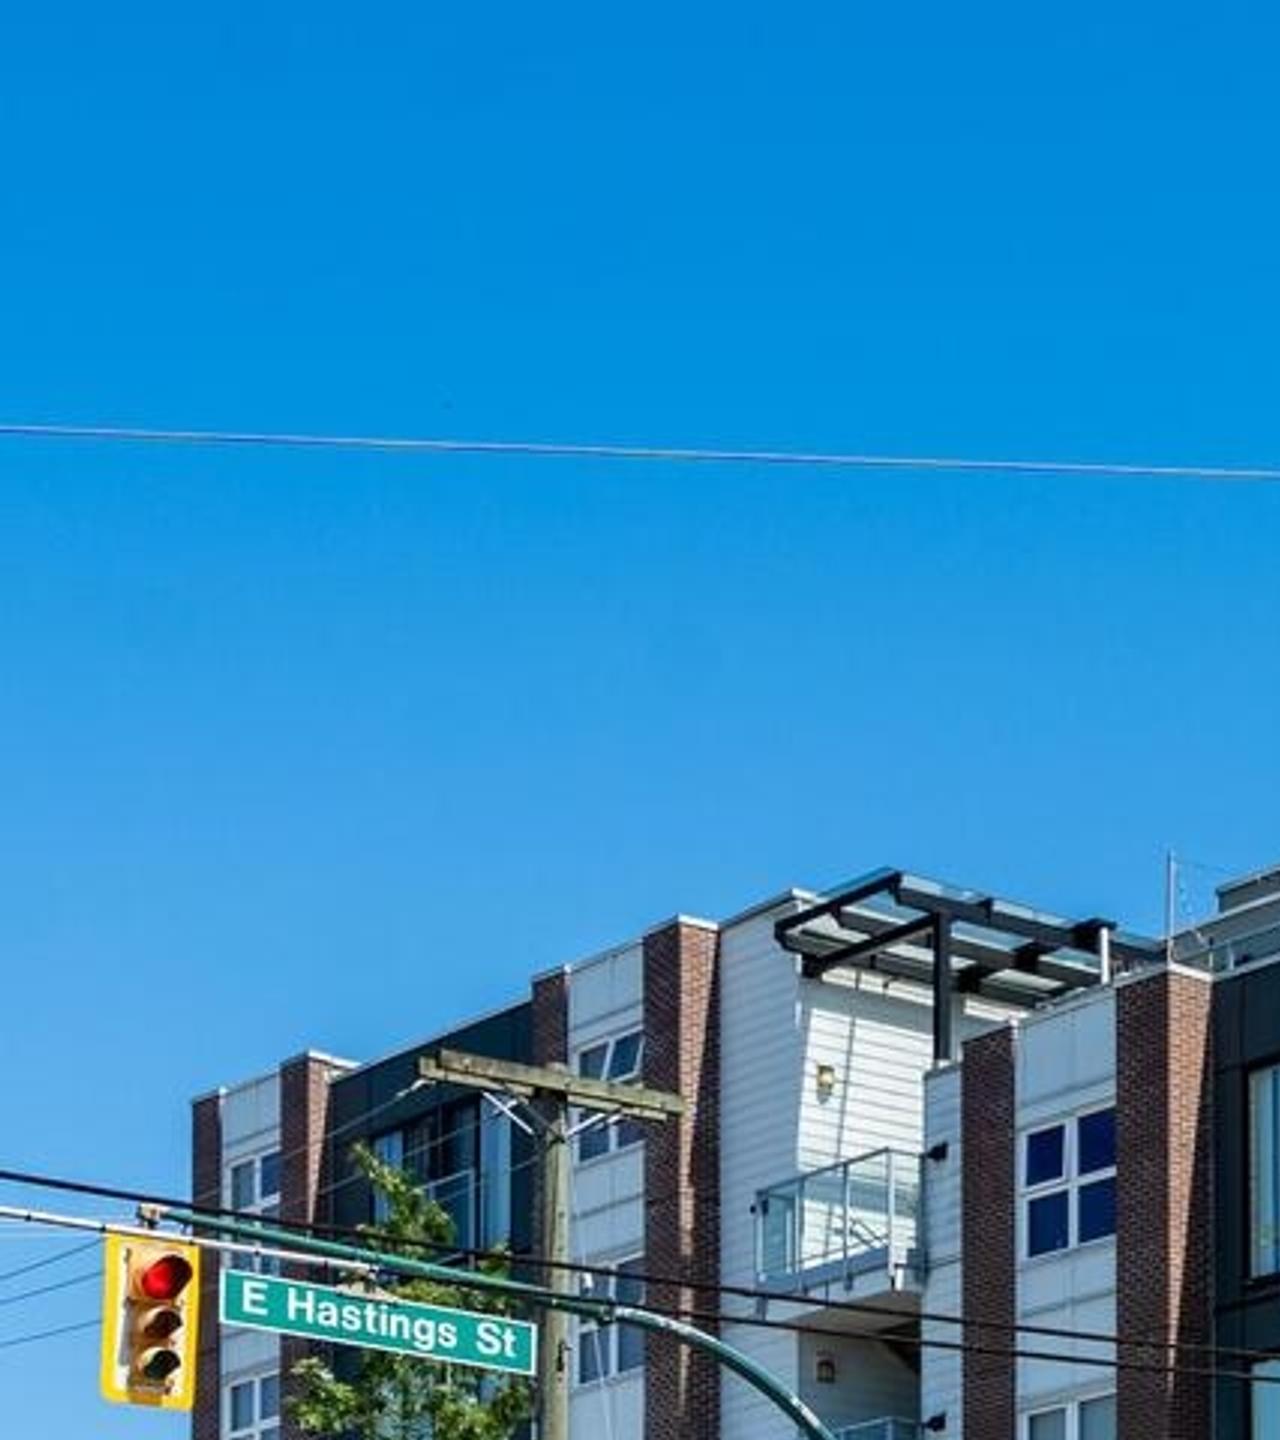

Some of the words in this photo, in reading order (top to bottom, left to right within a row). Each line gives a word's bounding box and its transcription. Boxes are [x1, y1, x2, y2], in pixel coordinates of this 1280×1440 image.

[241, 1281, 269, 1315] E
[287, 1287, 458, 1350] Hastings
[475, 1323, 518, 1358] St
